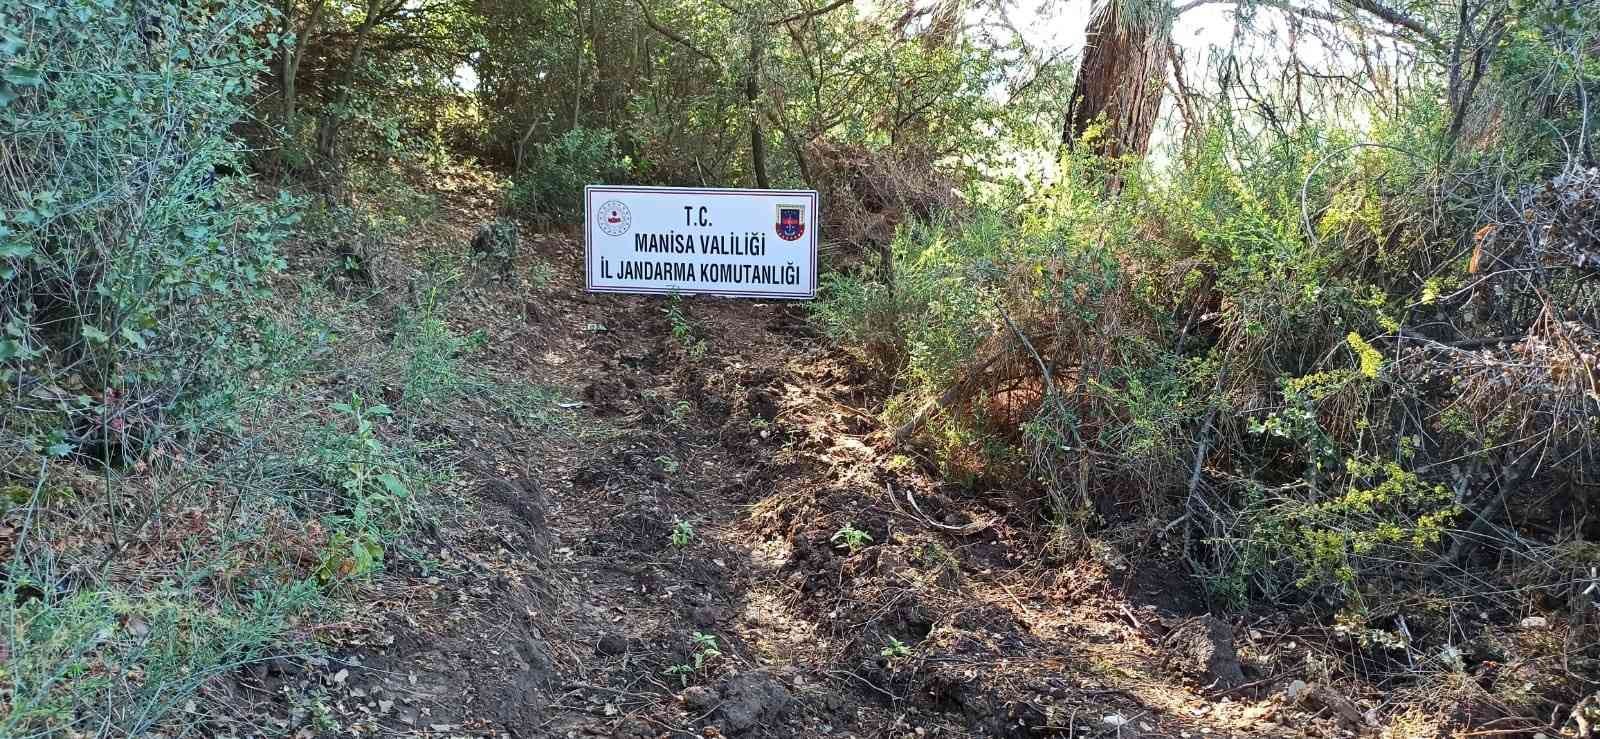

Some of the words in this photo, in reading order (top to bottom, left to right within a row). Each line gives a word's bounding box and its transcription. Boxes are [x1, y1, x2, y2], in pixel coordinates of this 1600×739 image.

[684, 206, 713, 227] T.C.
[634, 230, 695, 254] MANİSA
[700, 231, 765, 256] VALİLİĞİ
[600, 256, 613, 279] İL
[617, 260, 696, 282] JANDARMA
[700, 262, 800, 285] KOMUTANLIĞI
